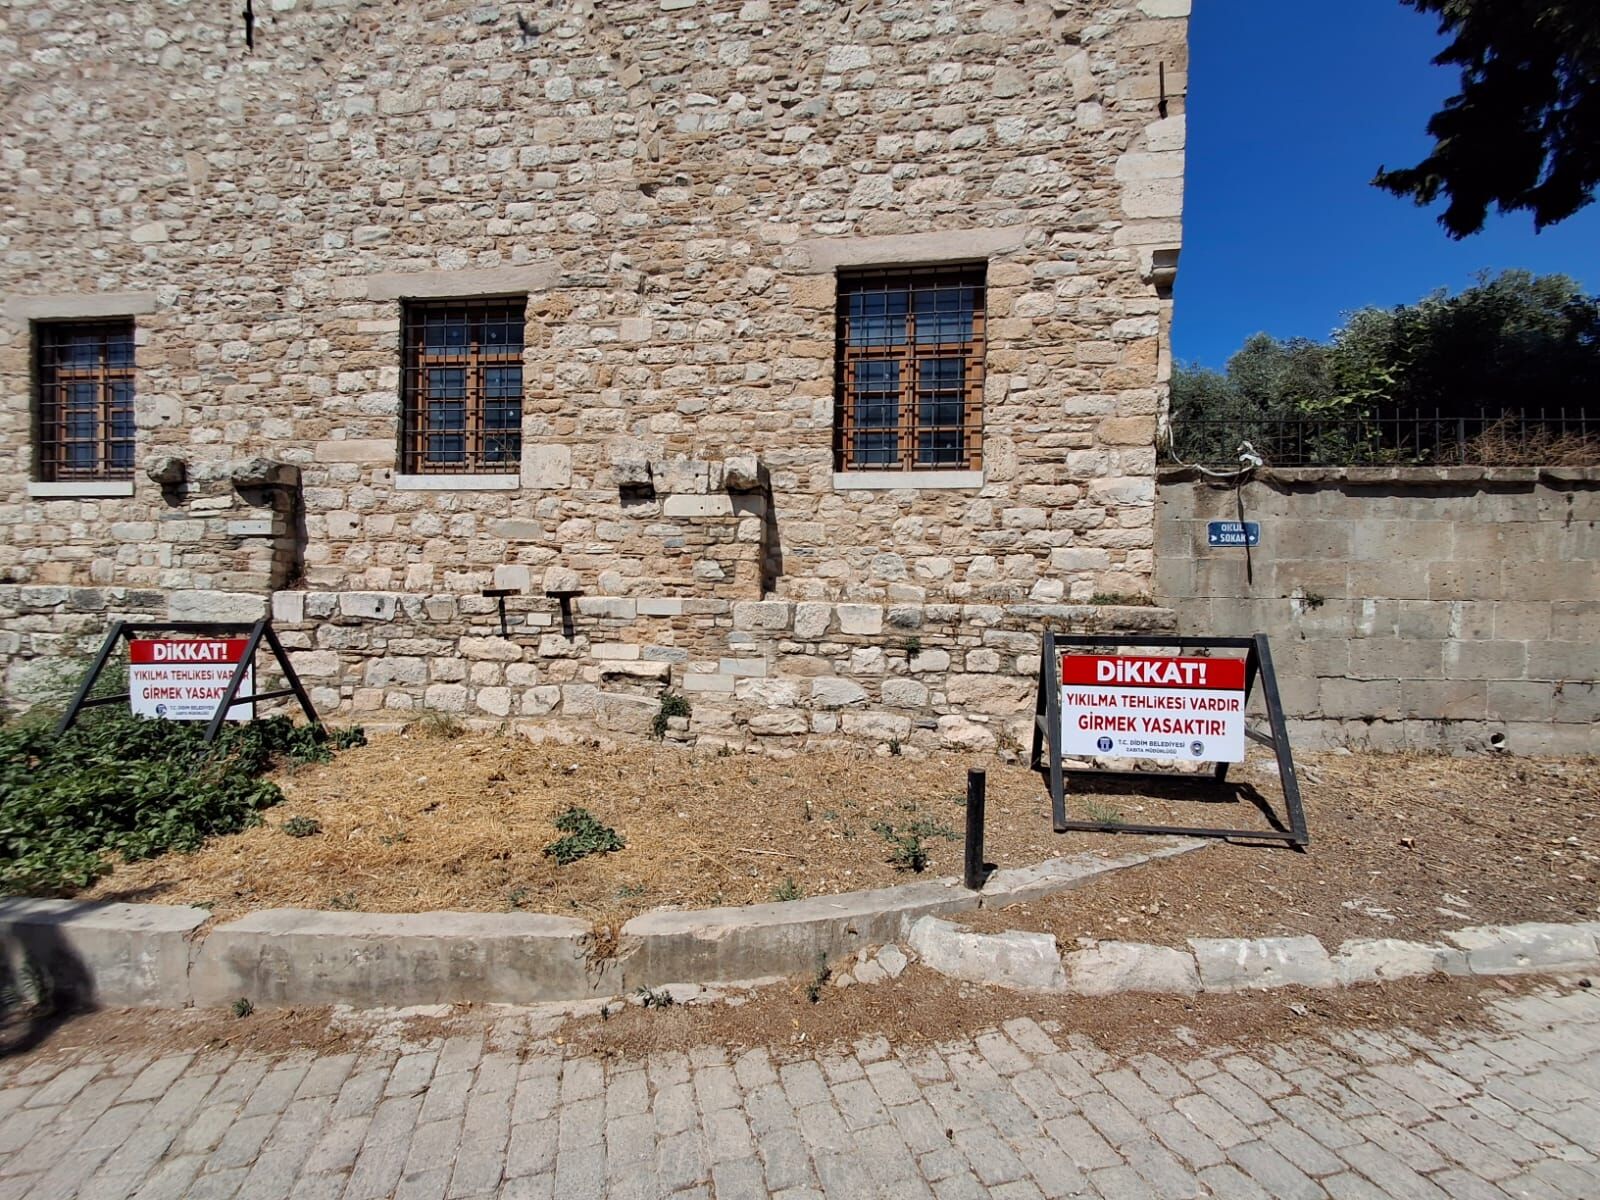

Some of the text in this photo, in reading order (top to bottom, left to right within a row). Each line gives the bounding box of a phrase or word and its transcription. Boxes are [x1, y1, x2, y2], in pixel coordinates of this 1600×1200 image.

[1221, 523, 1244, 532] OKUL
[1220, 533, 1246, 542] SOKAK
[133, 670, 168, 680] YIKILMA
[217, 670, 249, 680] VARR
[143, 684, 182, 699] GİRMEK
[1067, 693, 1117, 707] YIKILMA
[1190, 698, 1239, 712] VARDIR
[1078, 712, 1226, 736] GİRMEK YASAKTIR!
